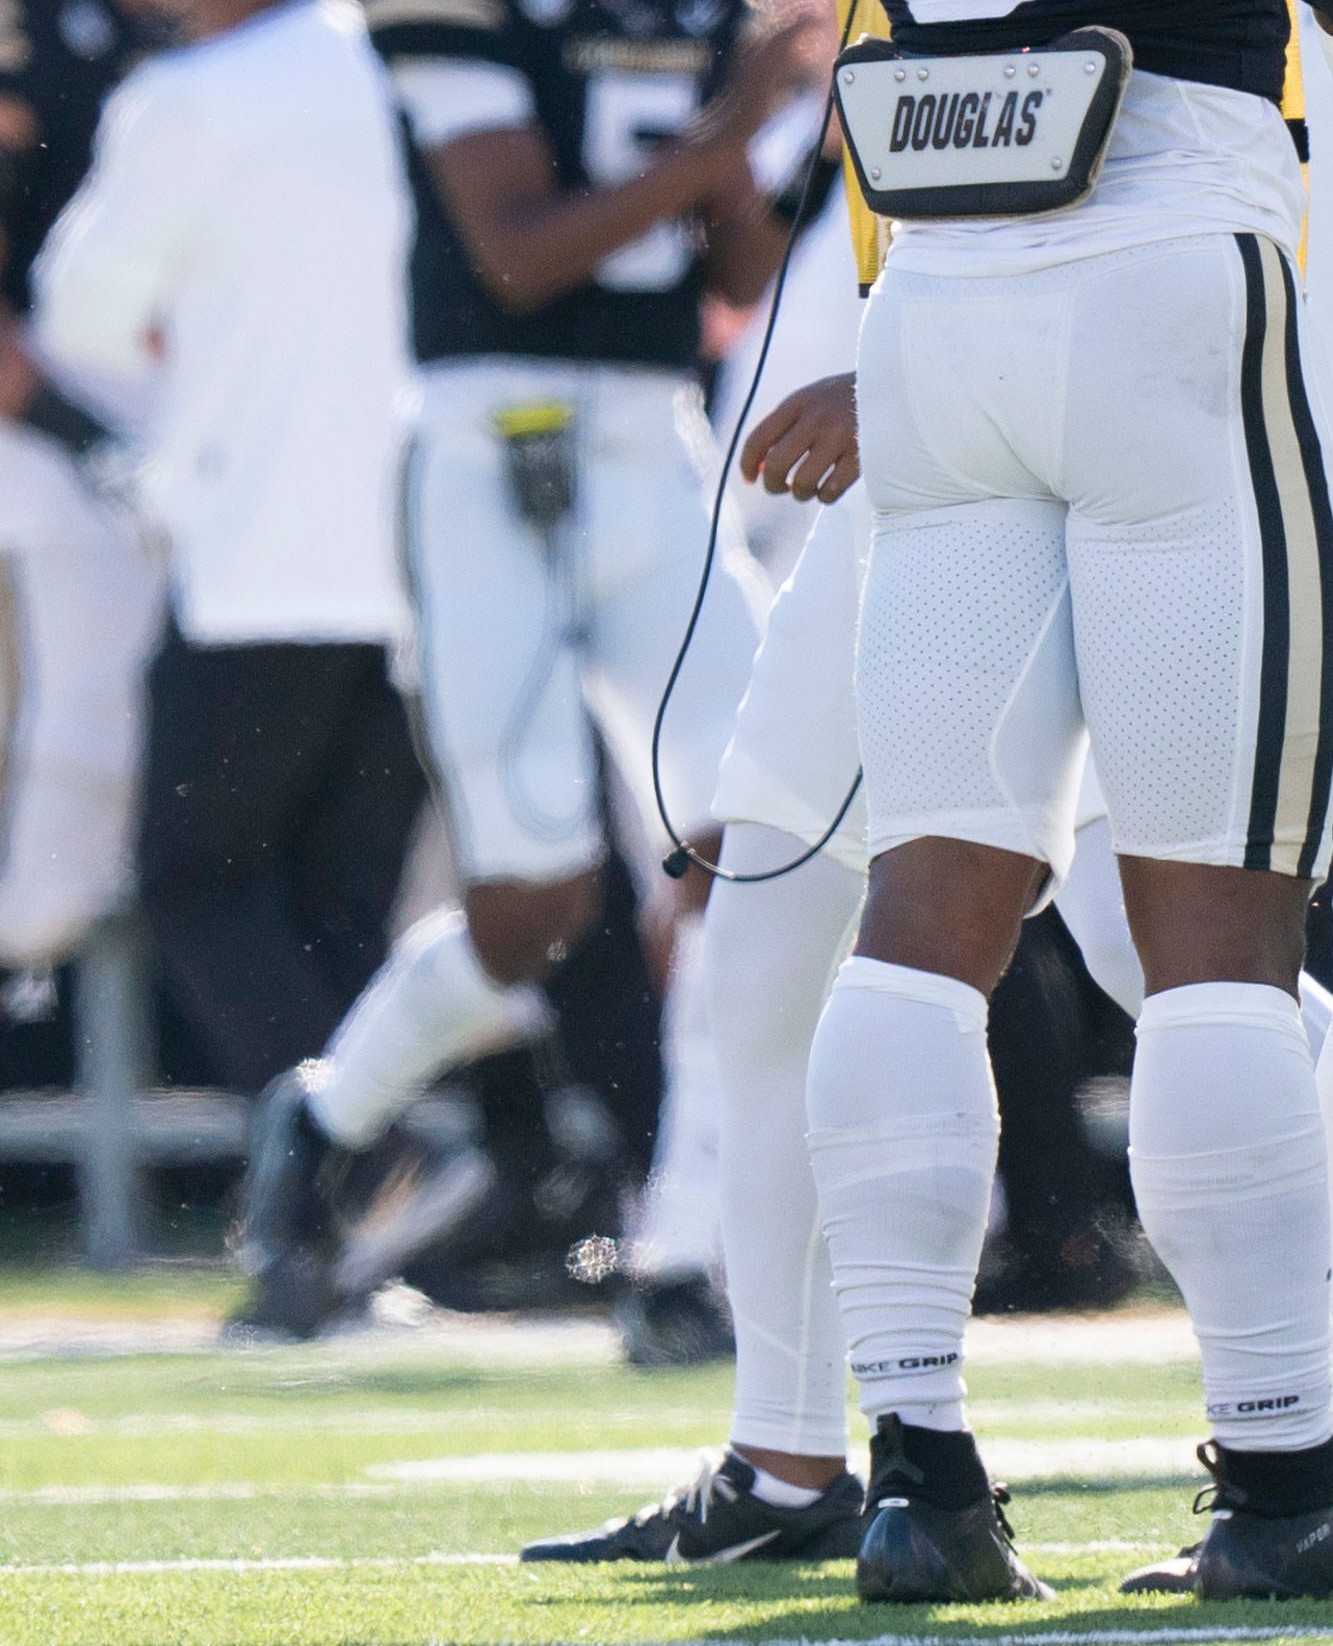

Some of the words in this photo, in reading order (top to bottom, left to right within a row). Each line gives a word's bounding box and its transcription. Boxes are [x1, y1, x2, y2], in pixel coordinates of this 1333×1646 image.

[889, 91, 1044, 152] DOUGLAS
[899, 1352, 959, 1371] GRIP
[1237, 1395, 1300, 1413] GRIP
